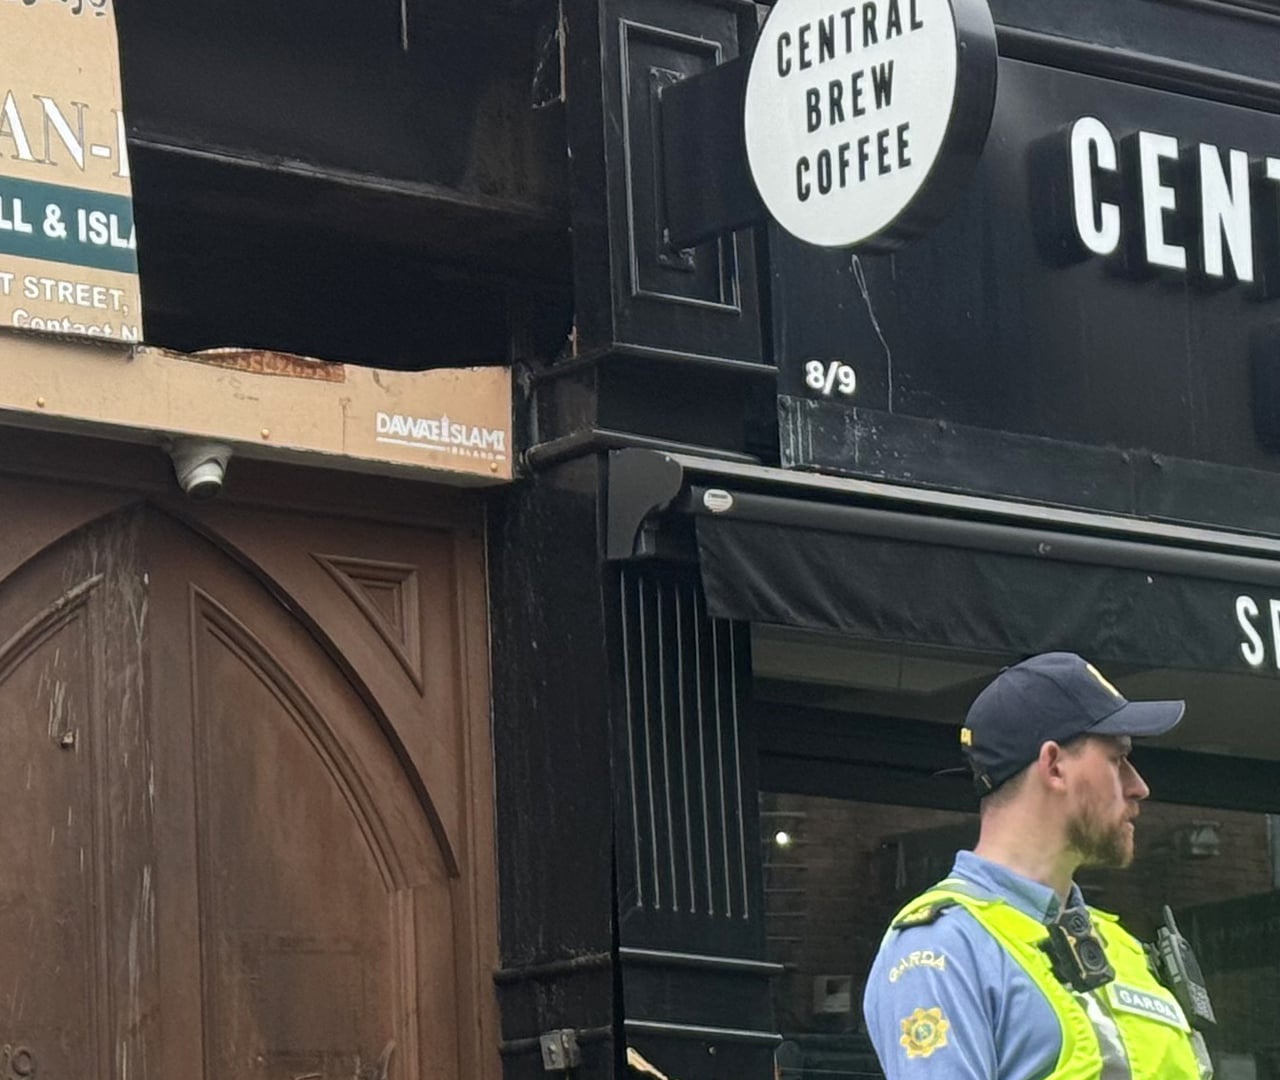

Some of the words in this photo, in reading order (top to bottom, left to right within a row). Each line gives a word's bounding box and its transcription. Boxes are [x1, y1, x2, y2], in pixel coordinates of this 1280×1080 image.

[777, 0, 924, 78] CENTRAL
[806, 60, 895, 133] BREW
[796, 121, 913, 202] COFFEE
[42, 204, 67, 239] &
[23, 276, 130, 317] STREET,
[803, 359, 858, 396] 8/9
[888, 950, 946, 983] GARDA
[1119, 989, 1177, 1020] GARDA
